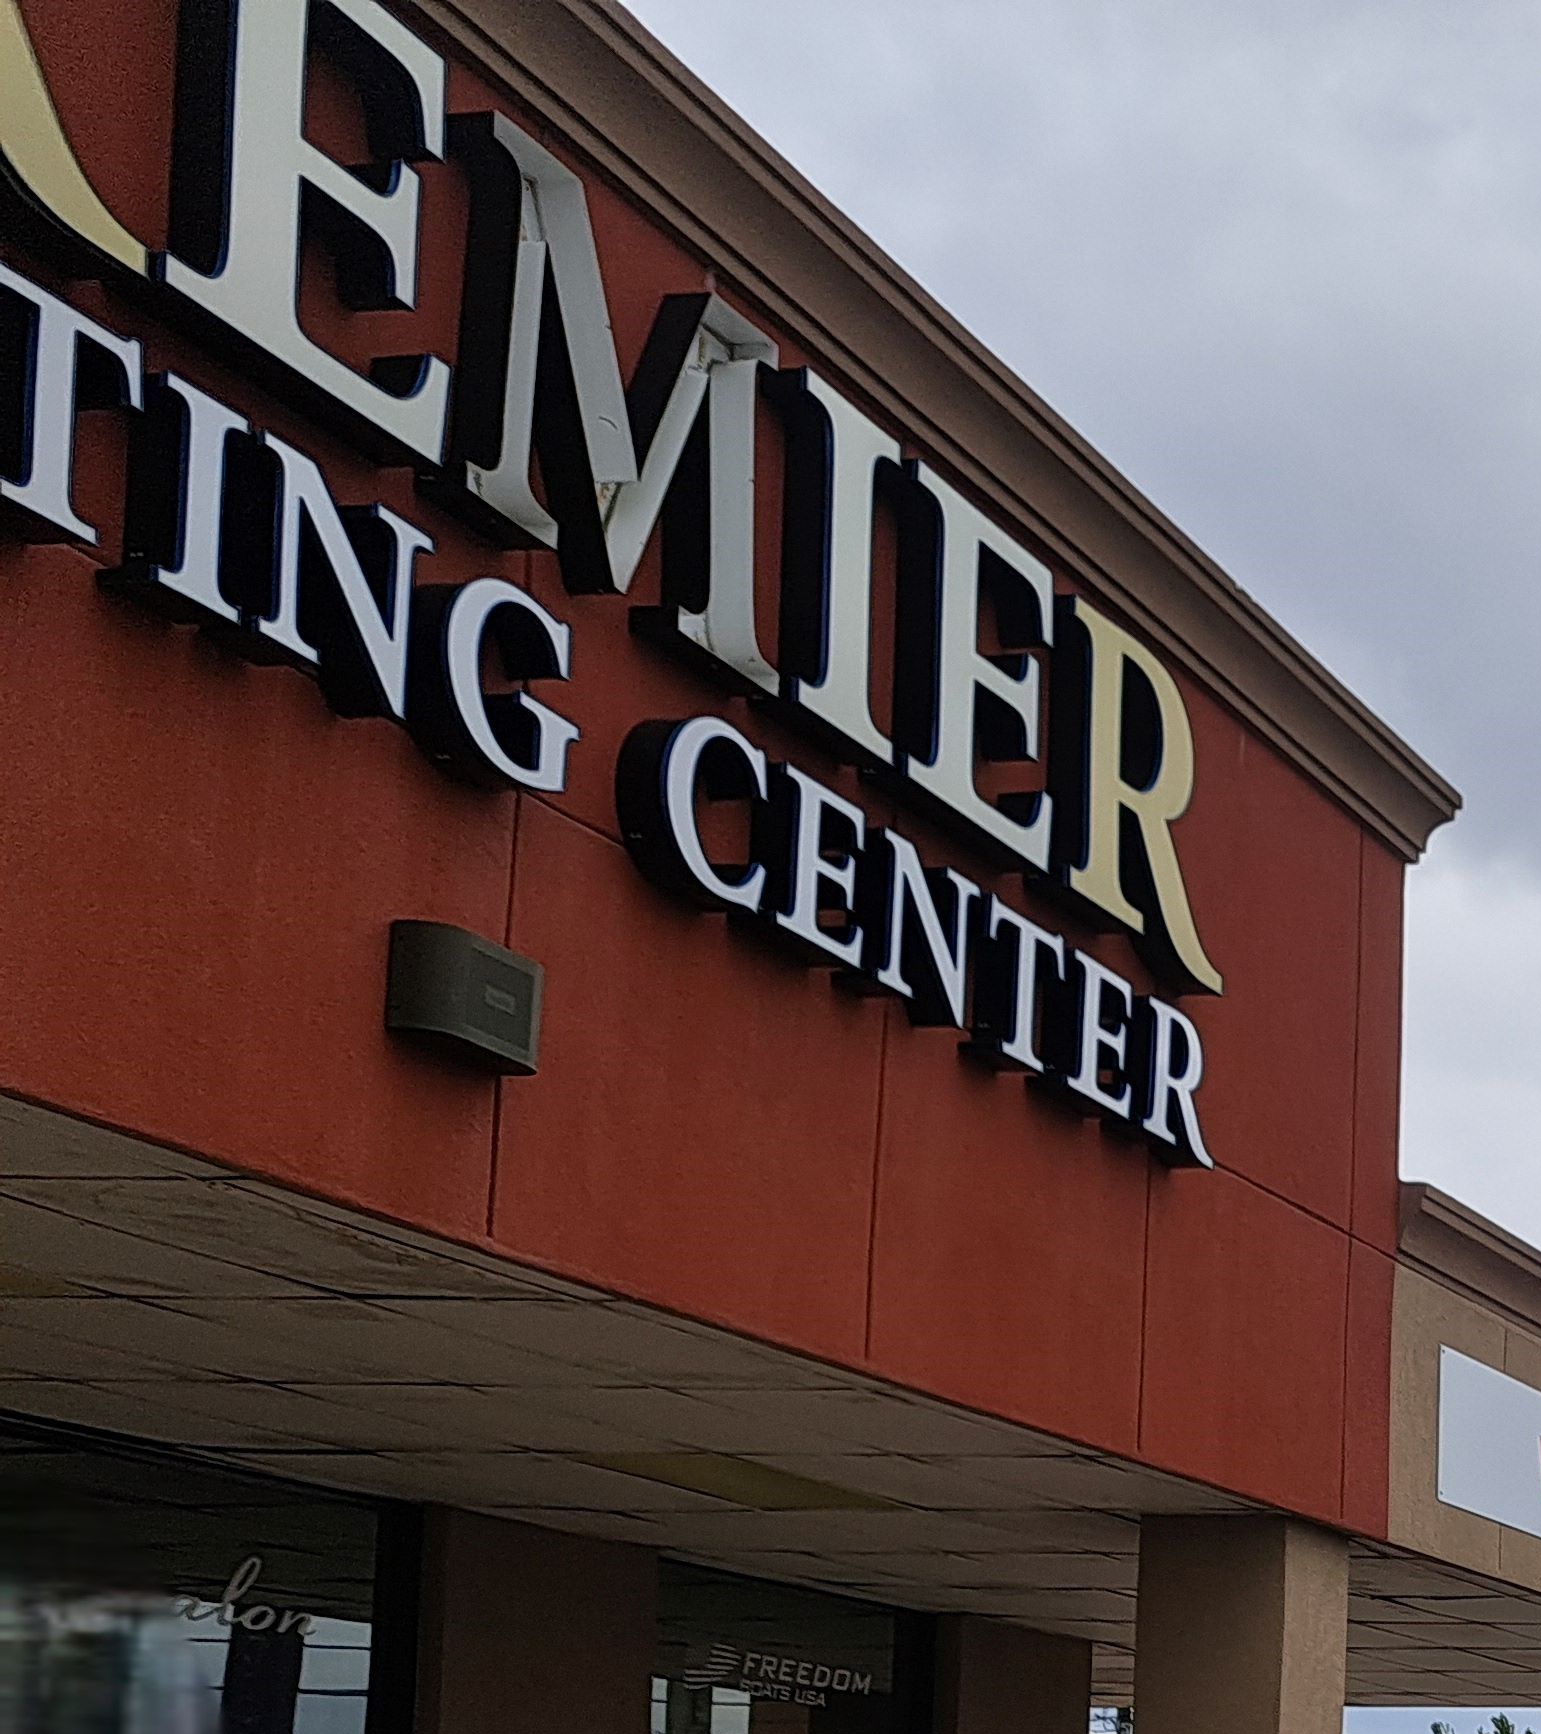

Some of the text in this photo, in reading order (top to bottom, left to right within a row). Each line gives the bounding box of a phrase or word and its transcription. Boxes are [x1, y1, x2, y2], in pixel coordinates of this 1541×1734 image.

[0, 0, 1223, 995] EMIER
[664, 715, 1215, 1170] CENTER
[742, 1651, 872, 1696] FREEDOM
[794, 1688, 827, 1708] USA
